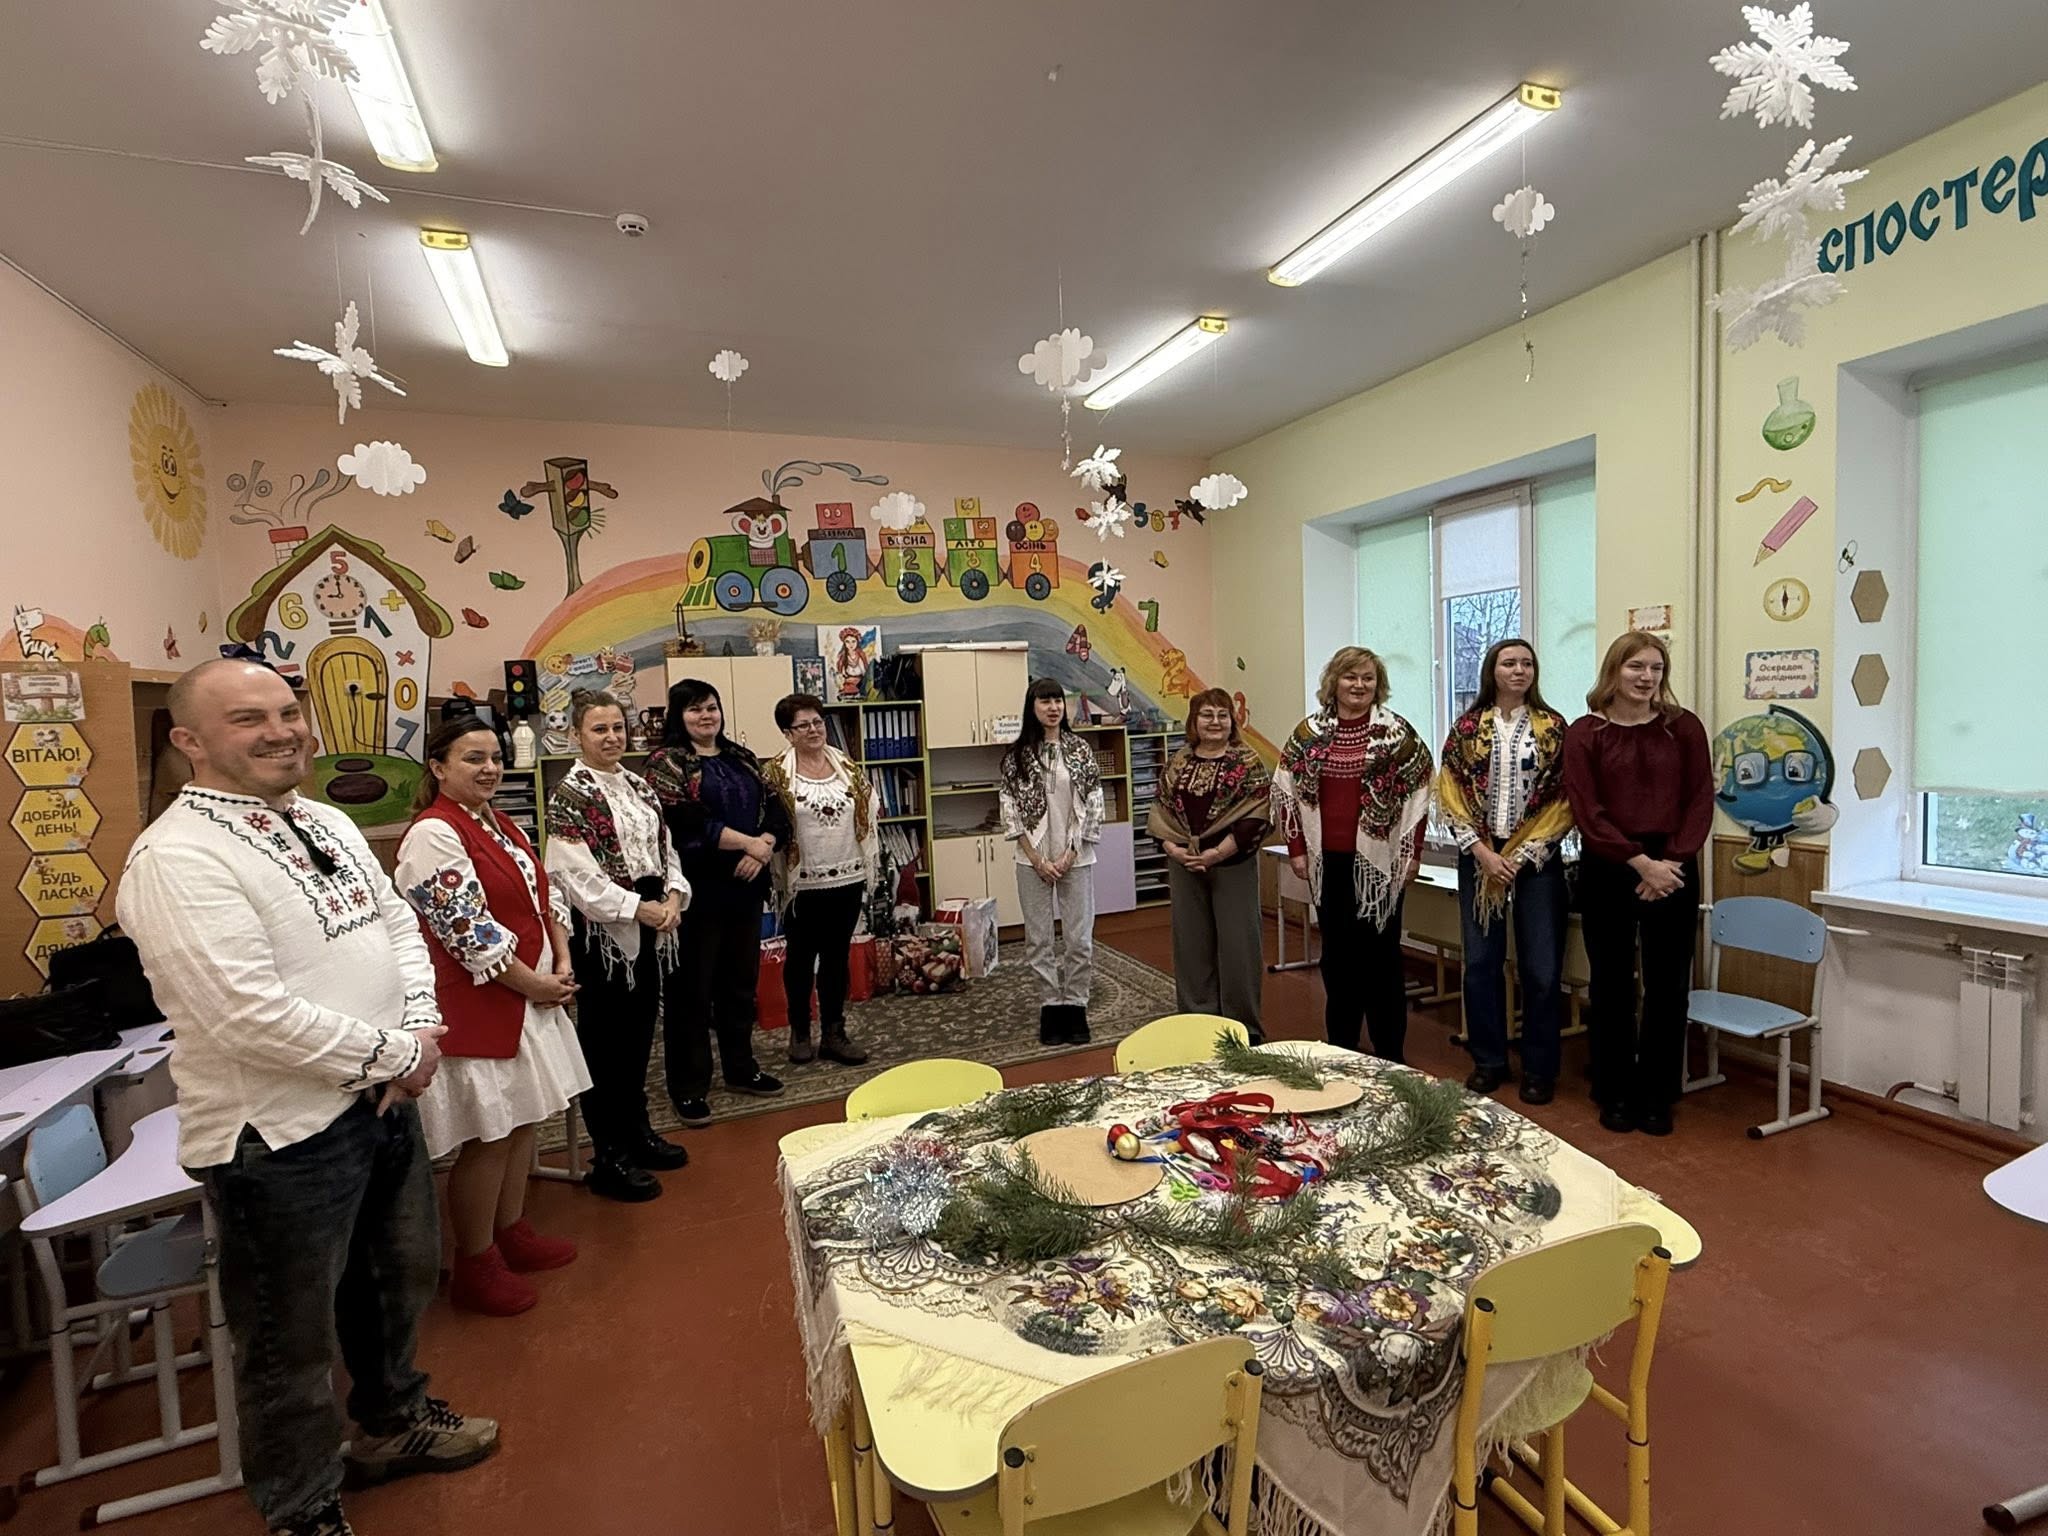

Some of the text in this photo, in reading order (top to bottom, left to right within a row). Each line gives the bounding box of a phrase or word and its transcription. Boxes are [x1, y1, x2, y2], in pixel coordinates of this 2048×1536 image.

[1134, 502, 1148, 528] 5
[330, 551, 349, 574] 5
[831, 542, 848, 573] 1
[903, 548, 920, 570] 2
[967, 550, 981, 568] 3
[1030, 553, 1042, 572] 4
[278, 592, 308, 629] 6
[394, 677, 418, 711] 0
[395, 717, 419, 752] 7
[12, 747, 81, 763] ВІТАЮ!
[21, 807, 82, 824] ДОБРИЙ
[34, 822, 77, 837] ДЕНЬ!
[42, 872, 82, 885] БУДЬ
[37, 886, 94, 901] ЛАСКА!
